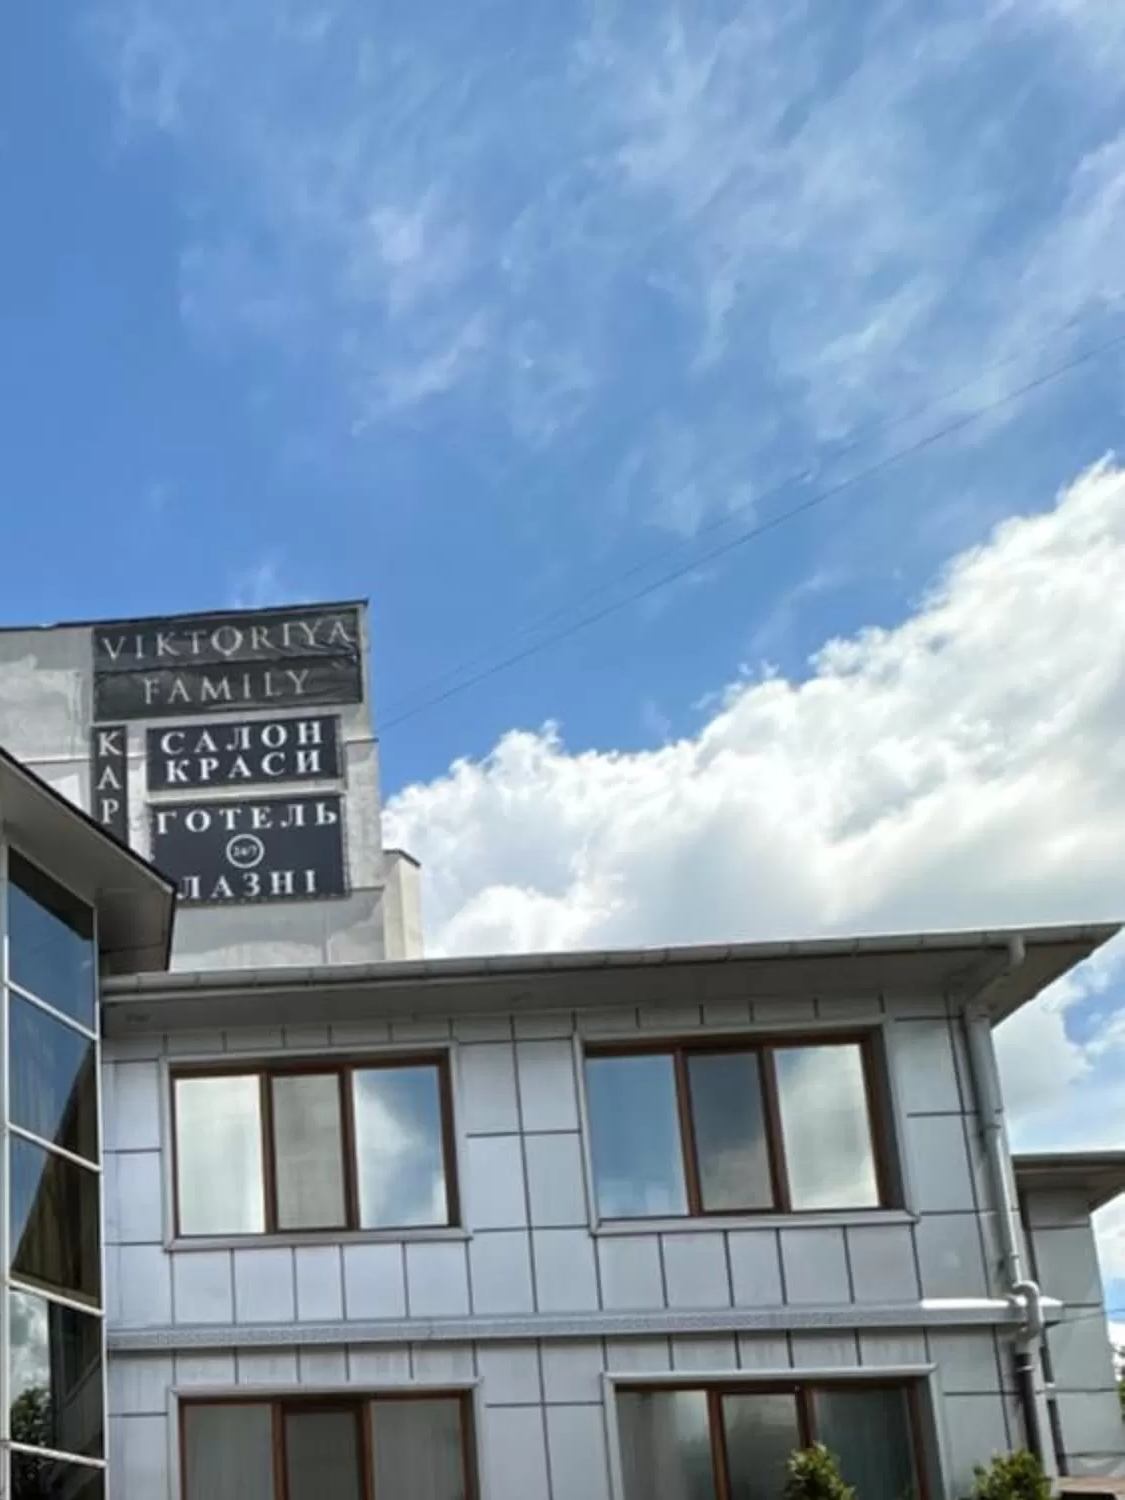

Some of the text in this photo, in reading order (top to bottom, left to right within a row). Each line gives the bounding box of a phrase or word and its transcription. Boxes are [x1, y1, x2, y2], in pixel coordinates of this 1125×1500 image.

[103, 620, 356, 661] VIKTORIYA
[142, 668, 310, 704] FAMILY
[160, 720, 323, 755] САЛОН
[166, 749, 321, 784] КРАСИ
[156, 802, 338, 836] ГОТЕЛЬ
[177, 869, 317, 900] ЛАЗНІ
